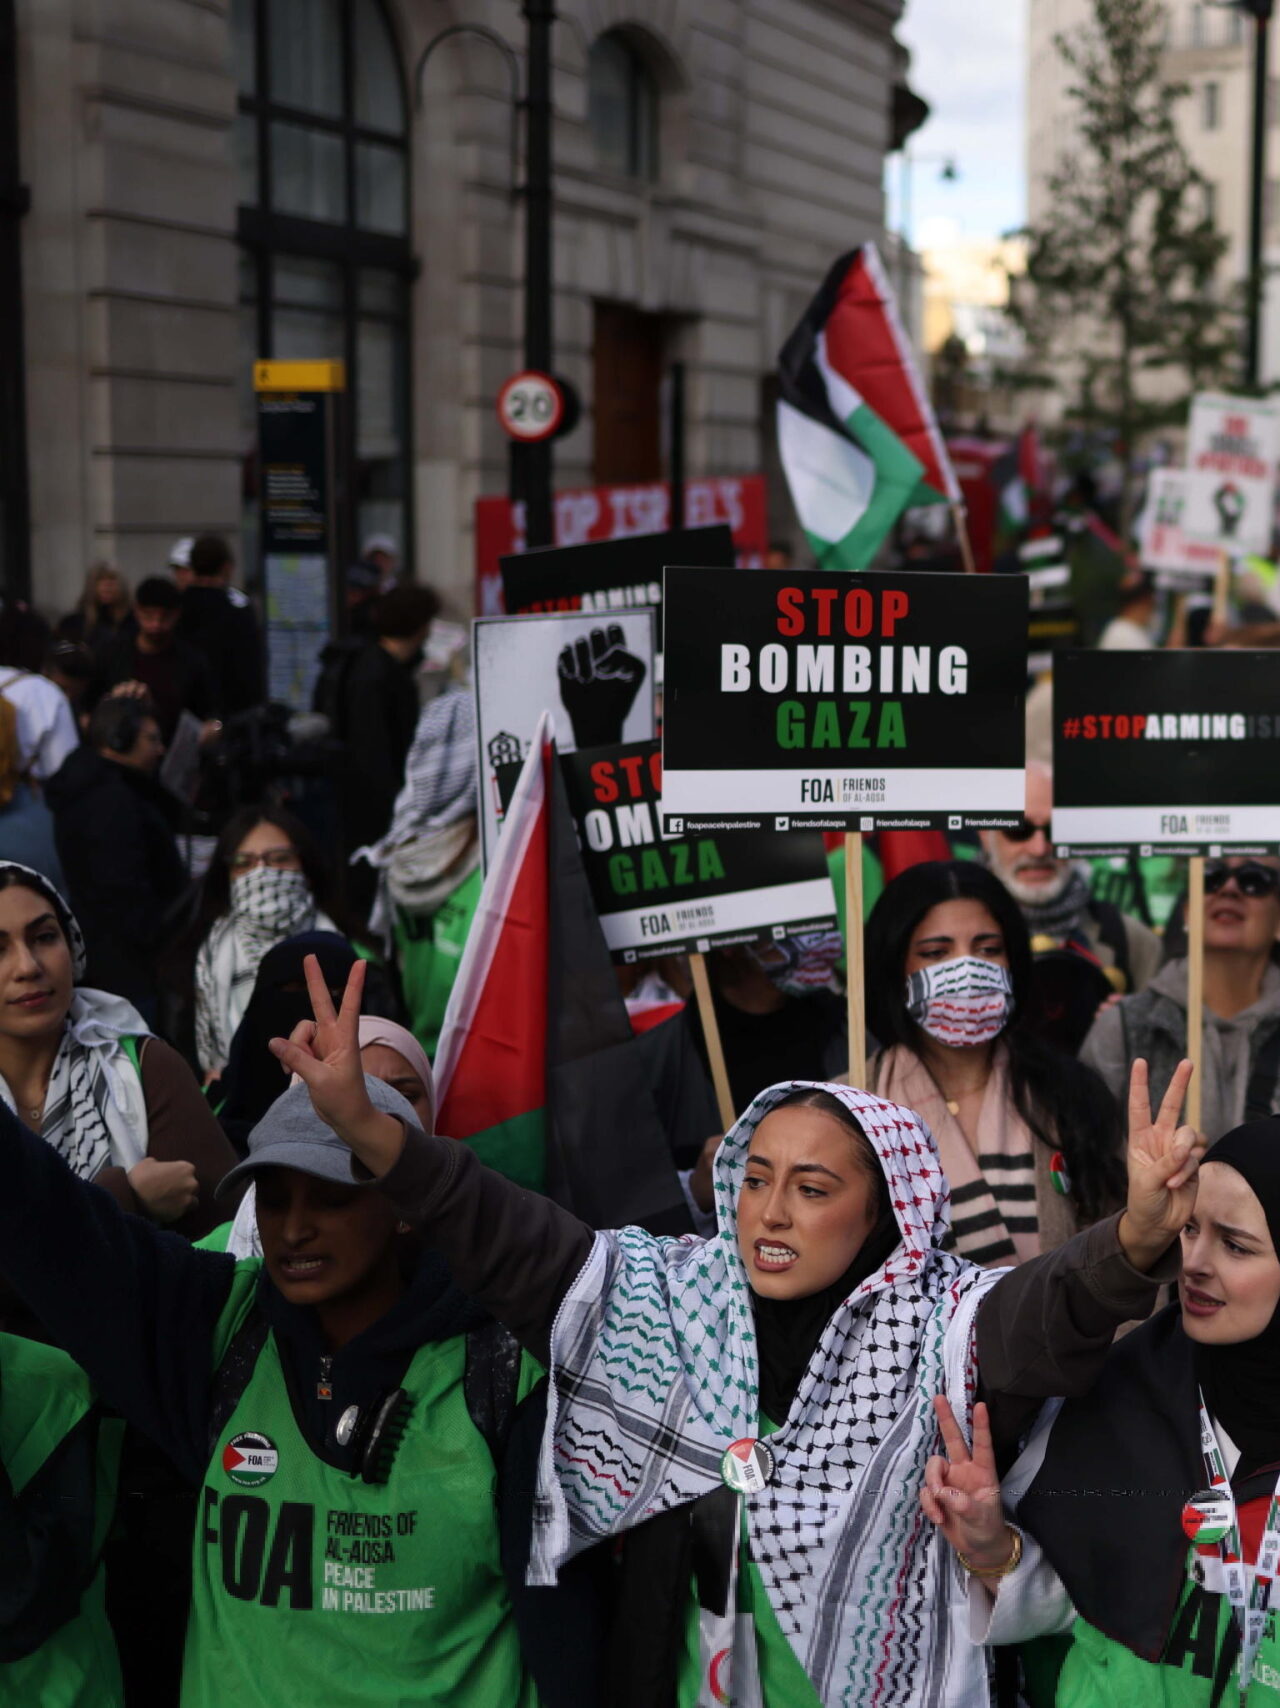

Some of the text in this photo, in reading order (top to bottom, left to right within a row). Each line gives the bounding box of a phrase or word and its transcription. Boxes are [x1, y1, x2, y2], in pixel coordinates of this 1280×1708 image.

[510, 391, 554, 422] 20
[777, 587, 909, 637] STOP
[721, 643, 968, 694] BOMBING
[776, 701, 907, 749] GAZA
[801, 778, 886, 803] FOA FRIENDS
[687, 819, 761, 831] foapeaceinpalestine
[791, 818, 846, 830] friendsofalaqsa
[876, 817, 931, 829] friendsofalaqsa
[965, 817, 1020, 829] friendsofalaqsa
[1160, 815, 1188, 834] FOA
[608, 839, 726, 896] GAZA
[640, 914, 672, 937] FOA
[247, 1454, 263, 1467] FOA
[743, 1464, 756, 1480] FOA
[327, 1510, 418, 1539] FRIENDS OF
[325, 1539, 396, 1564] AL-AQSA
[324, 1560, 376, 1589] PEACE
[322, 1587, 436, 1614] IN PALESTINE
